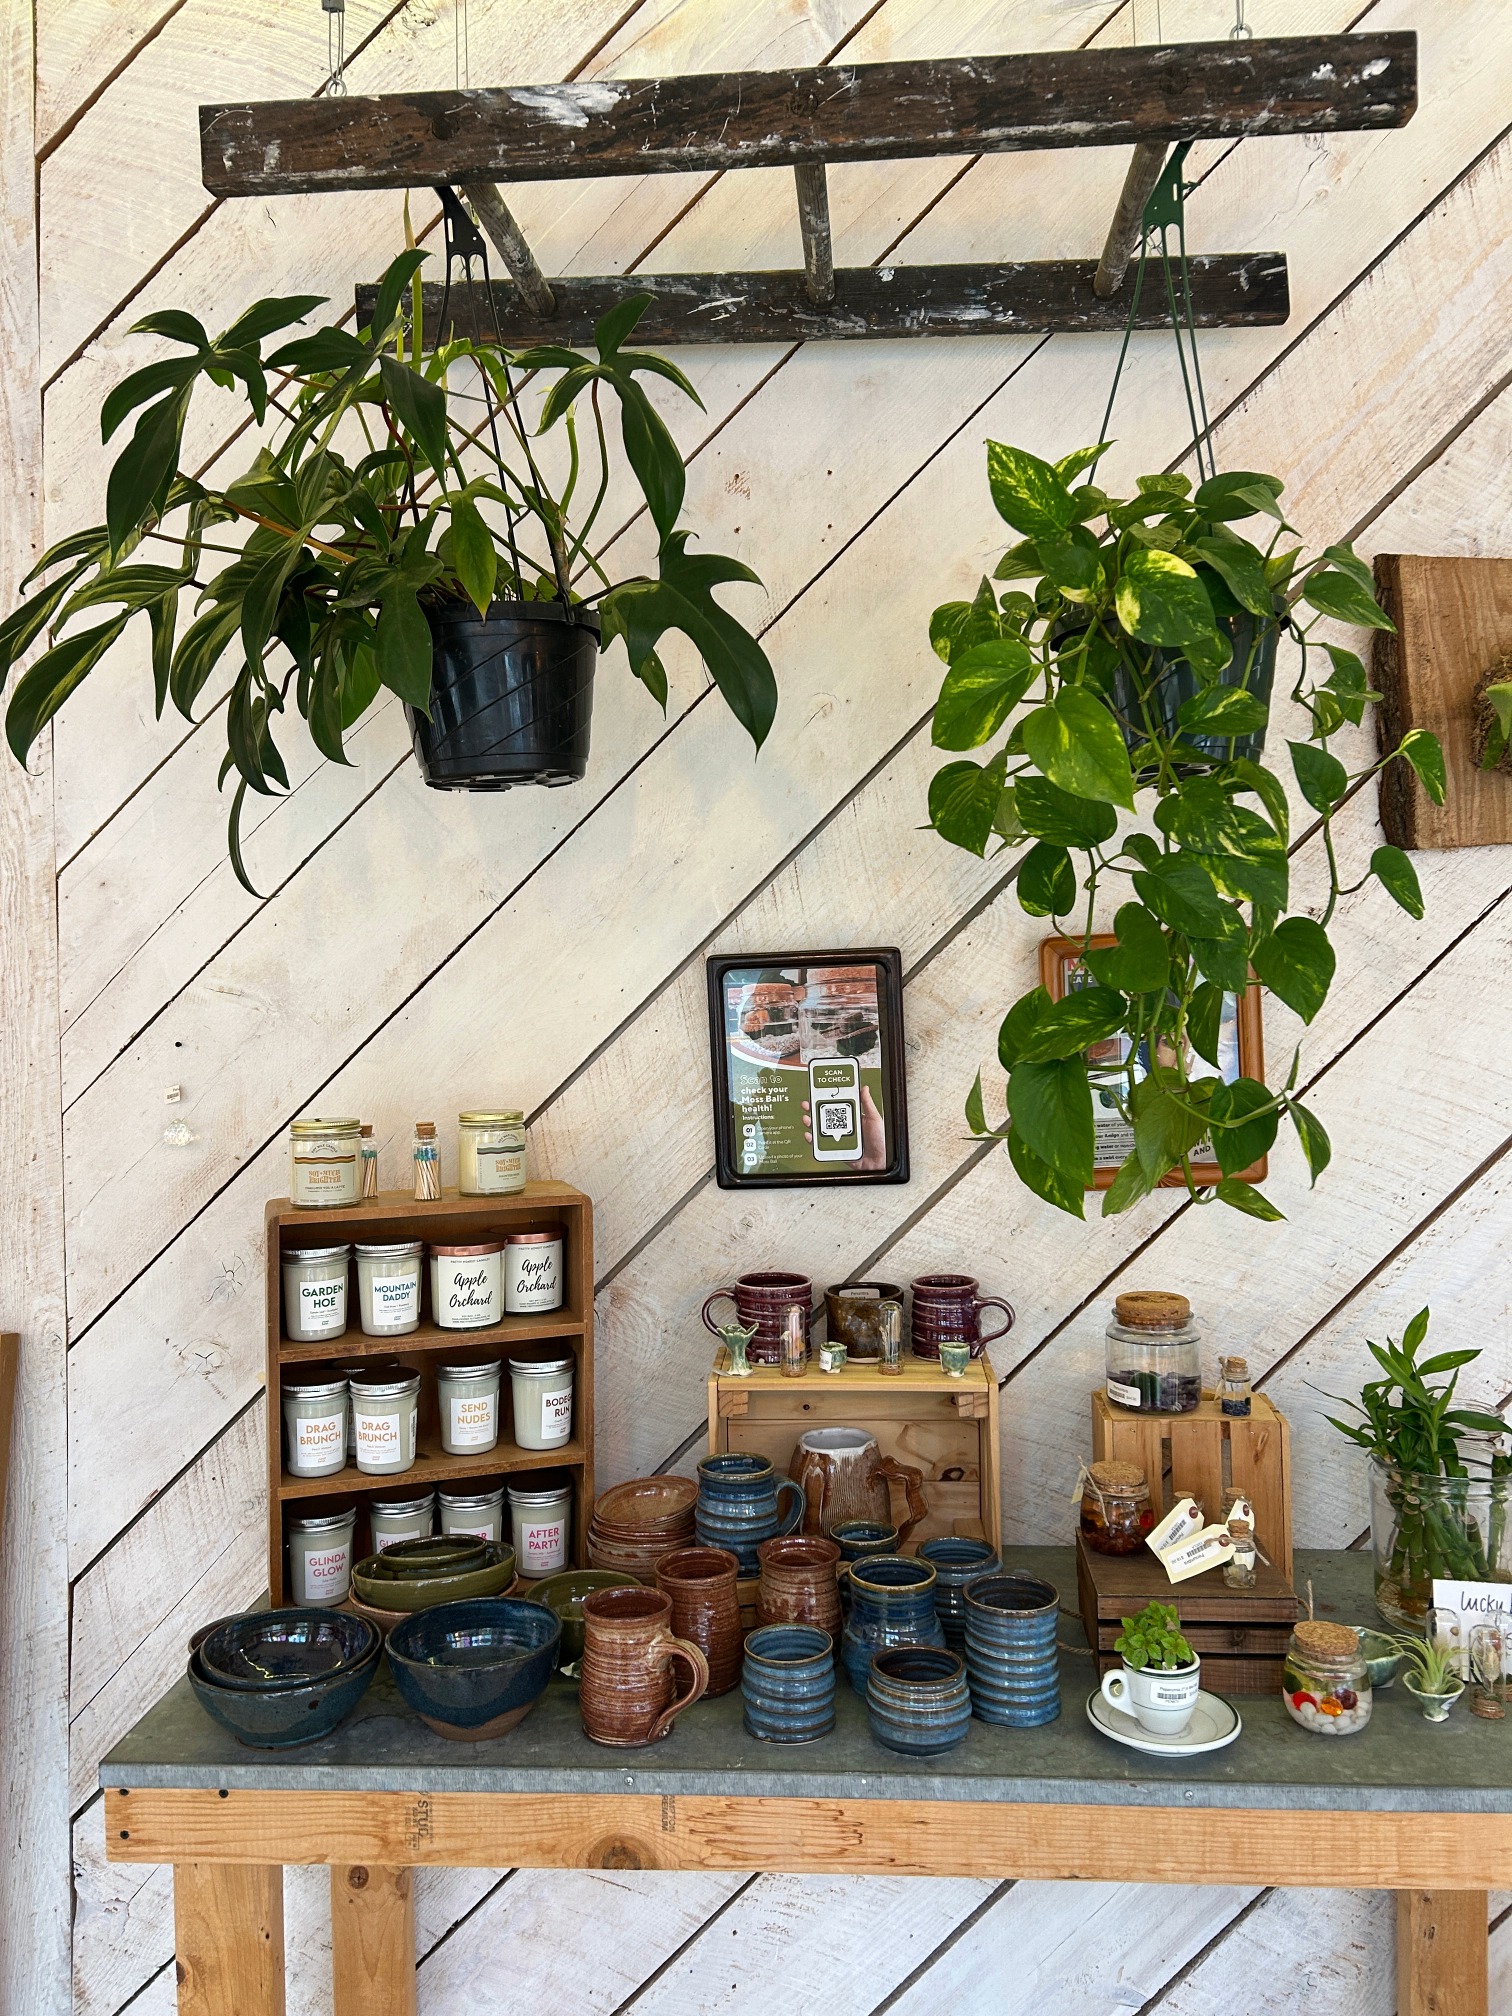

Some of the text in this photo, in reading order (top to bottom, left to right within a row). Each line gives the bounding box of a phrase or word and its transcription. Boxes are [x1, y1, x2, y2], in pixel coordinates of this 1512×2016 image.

[740, 1075, 783, 1085] Scan to
[741, 1087, 789, 1095] check your
[742, 1096, 764, 1104] Moss
[742, 1104, 773, 1112] health!
[1193, 1145, 1211, 1157] AND
[521, 1255, 553, 1277] Apple
[453, 1269, 488, 1291] Apple
[516, 1274, 557, 1293] Orchard
[302, 1283, 343, 1297] GARDEN
[374, 1281, 416, 1293] MOUNTAIN
[383, 1291, 411, 1301] DADDY
[449, 1289, 493, 1308] Orchard
[313, 1297, 336, 1308] HOE
[545, 1393, 572, 1408] BODEG
[461, 1402, 488, 1413] SEND
[554, 1406, 570, 1418] RUN
[457, 1412, 491, 1424] NUDES
[306, 1422, 336, 1434] DRAG
[362, 1421, 391, 1431] DRAG
[300, 1431, 341, 1445] BRUNCH
[358, 1432, 397, 1442] BRUNCH
[528, 1527, 559, 1539] AFTER
[528, 1538, 559, 1550] PARTY
[309, 1552, 346, 1566] GLINDA
[313, 1563, 344, 1577] GLOW
[1461, 1591, 1504, 1614] lucky
[417, 1800, 429, 1837] STUD
[661, 1795, 669, 1831] REMIUM
